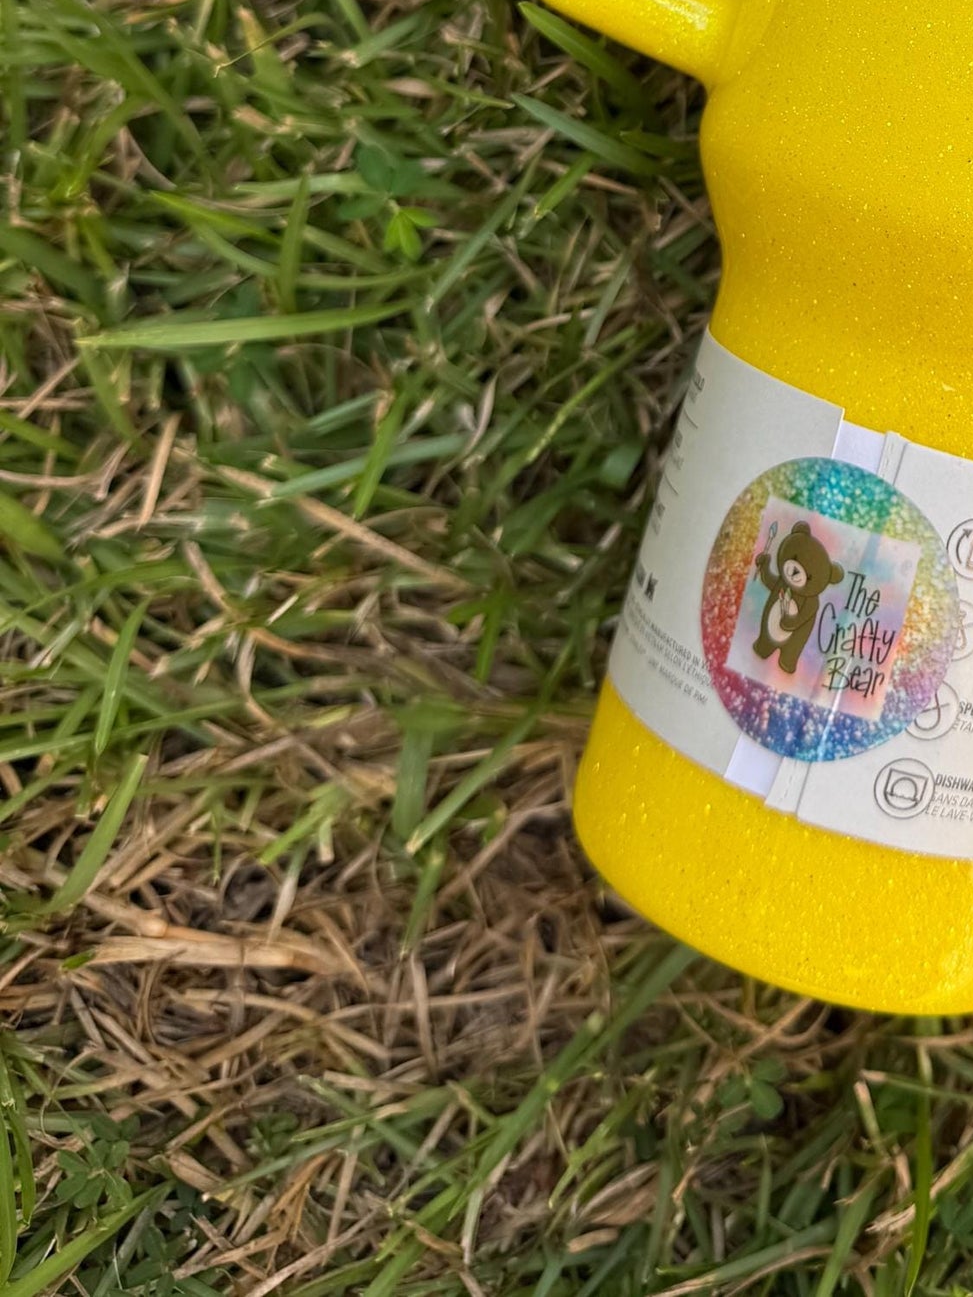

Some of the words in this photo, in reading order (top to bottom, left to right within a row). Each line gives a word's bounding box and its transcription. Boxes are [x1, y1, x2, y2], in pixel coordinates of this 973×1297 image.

[844, 571, 881, 618] The
[818, 602, 896, 665] Crafty
[822, 656, 885, 698] Bear
[930, 791, 960, 806] SANS
